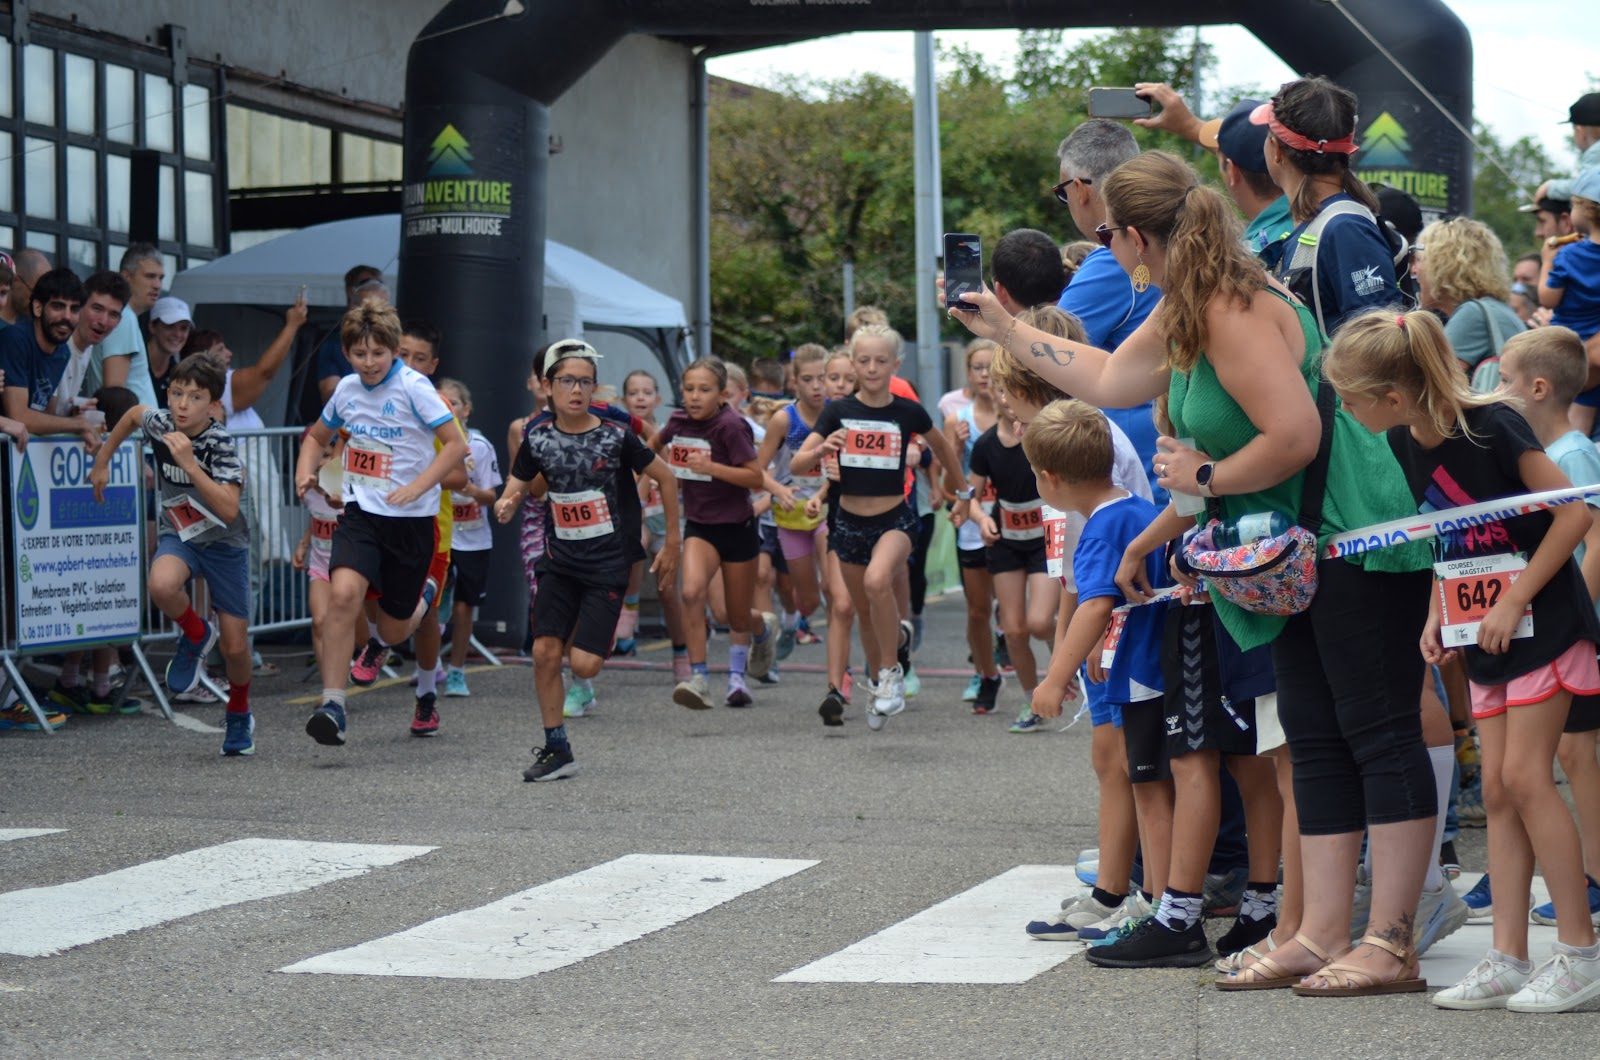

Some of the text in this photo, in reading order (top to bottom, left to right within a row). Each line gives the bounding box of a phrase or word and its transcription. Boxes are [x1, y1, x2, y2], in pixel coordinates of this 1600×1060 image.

[370, 426, 402, 439] CGM
[855, 433, 886, 450] 624
[354, 451, 376, 471] 721
[673, 447, 690, 463] 62
[561, 504, 592, 522] 616
[1011, 511, 1040, 526] 618
[52, 535, 60, 548] DE
[62, 534, 83, 547] VOTRE
[85, 532, 112, 547] TOITURE
[1447, 561, 1474, 571] COURSES
[1459, 566, 1493, 576] MAGSTATT
[31, 582, 71, 600] Membrane
[72, 581, 88, 597] PVC
[94, 578, 126, 595] Isolation
[1457, 578, 1502, 612] 642
[21, 601, 53, 618] Entretien
[114, 594, 138, 610] toiture
